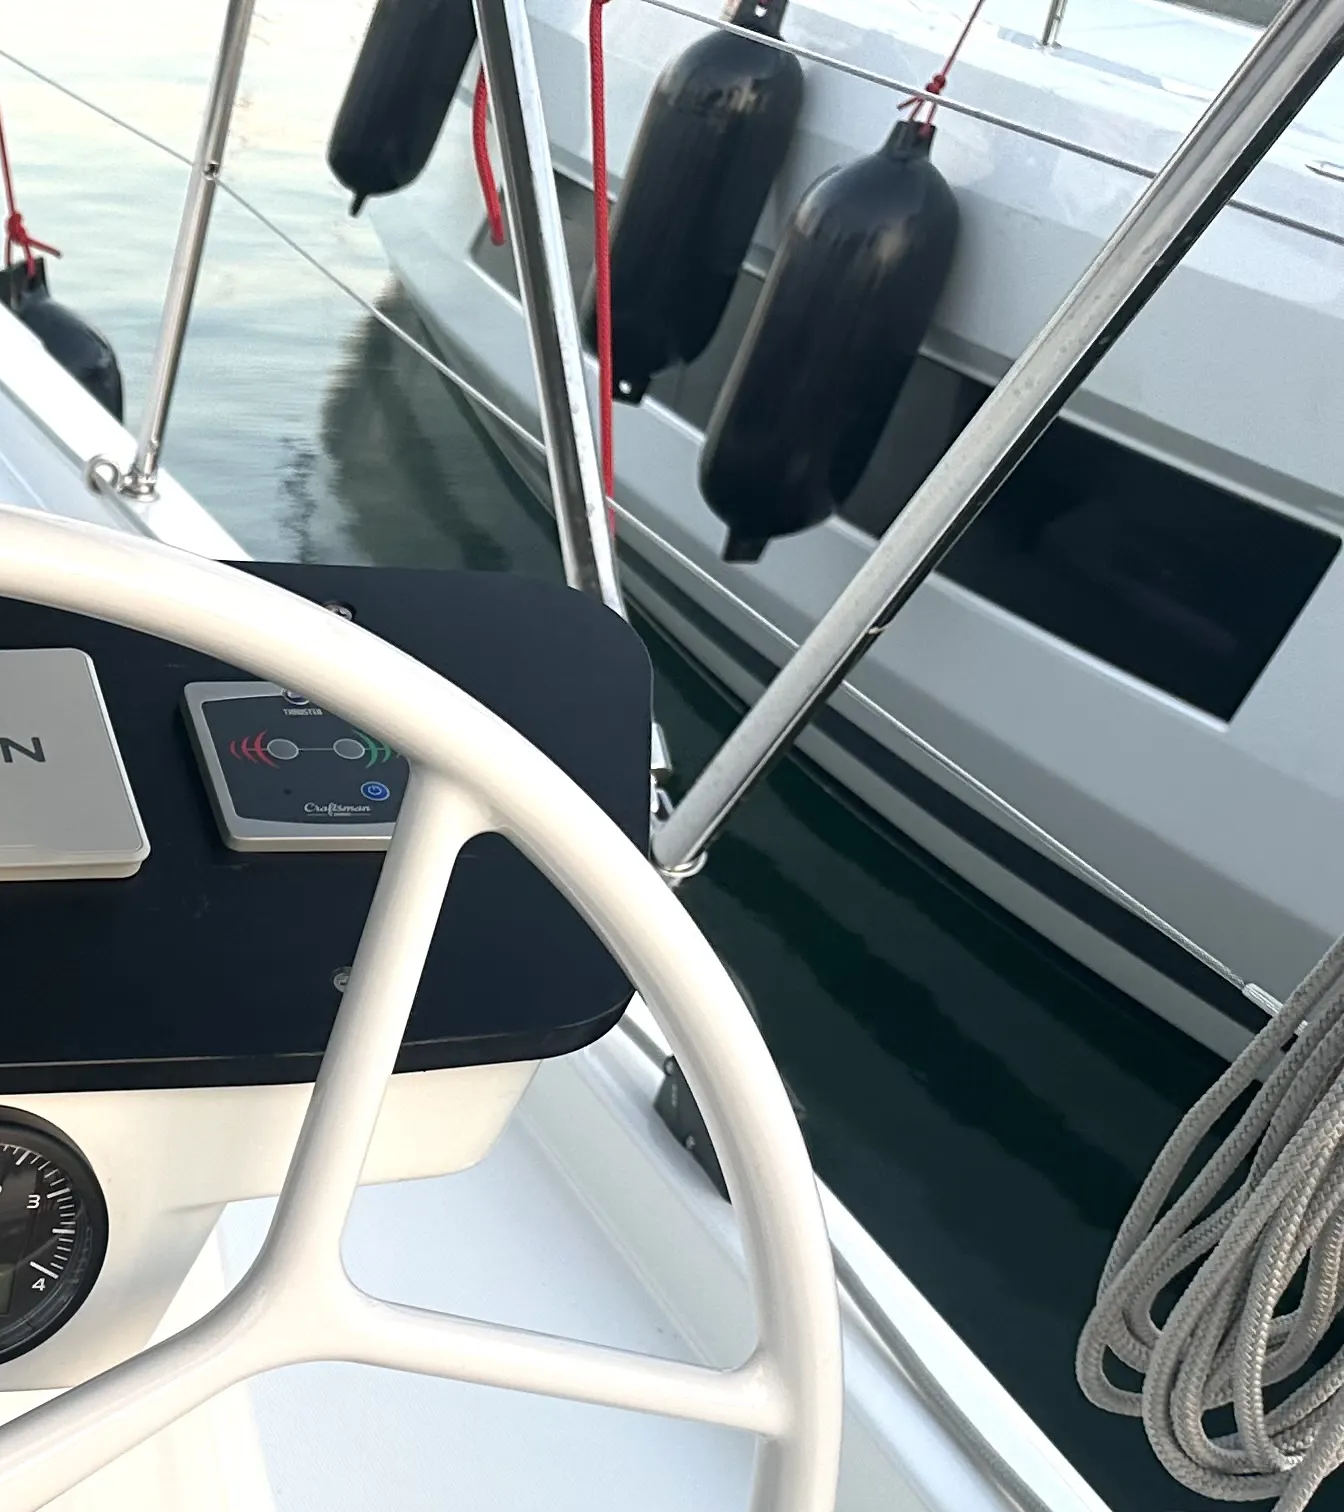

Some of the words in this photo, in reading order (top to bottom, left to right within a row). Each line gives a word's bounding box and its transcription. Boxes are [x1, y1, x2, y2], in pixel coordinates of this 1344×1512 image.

[304, 802, 371, 816] Craftsman
[26, 1194, 41, 1210] 3
[31, 1277, 47, 1292] 4
